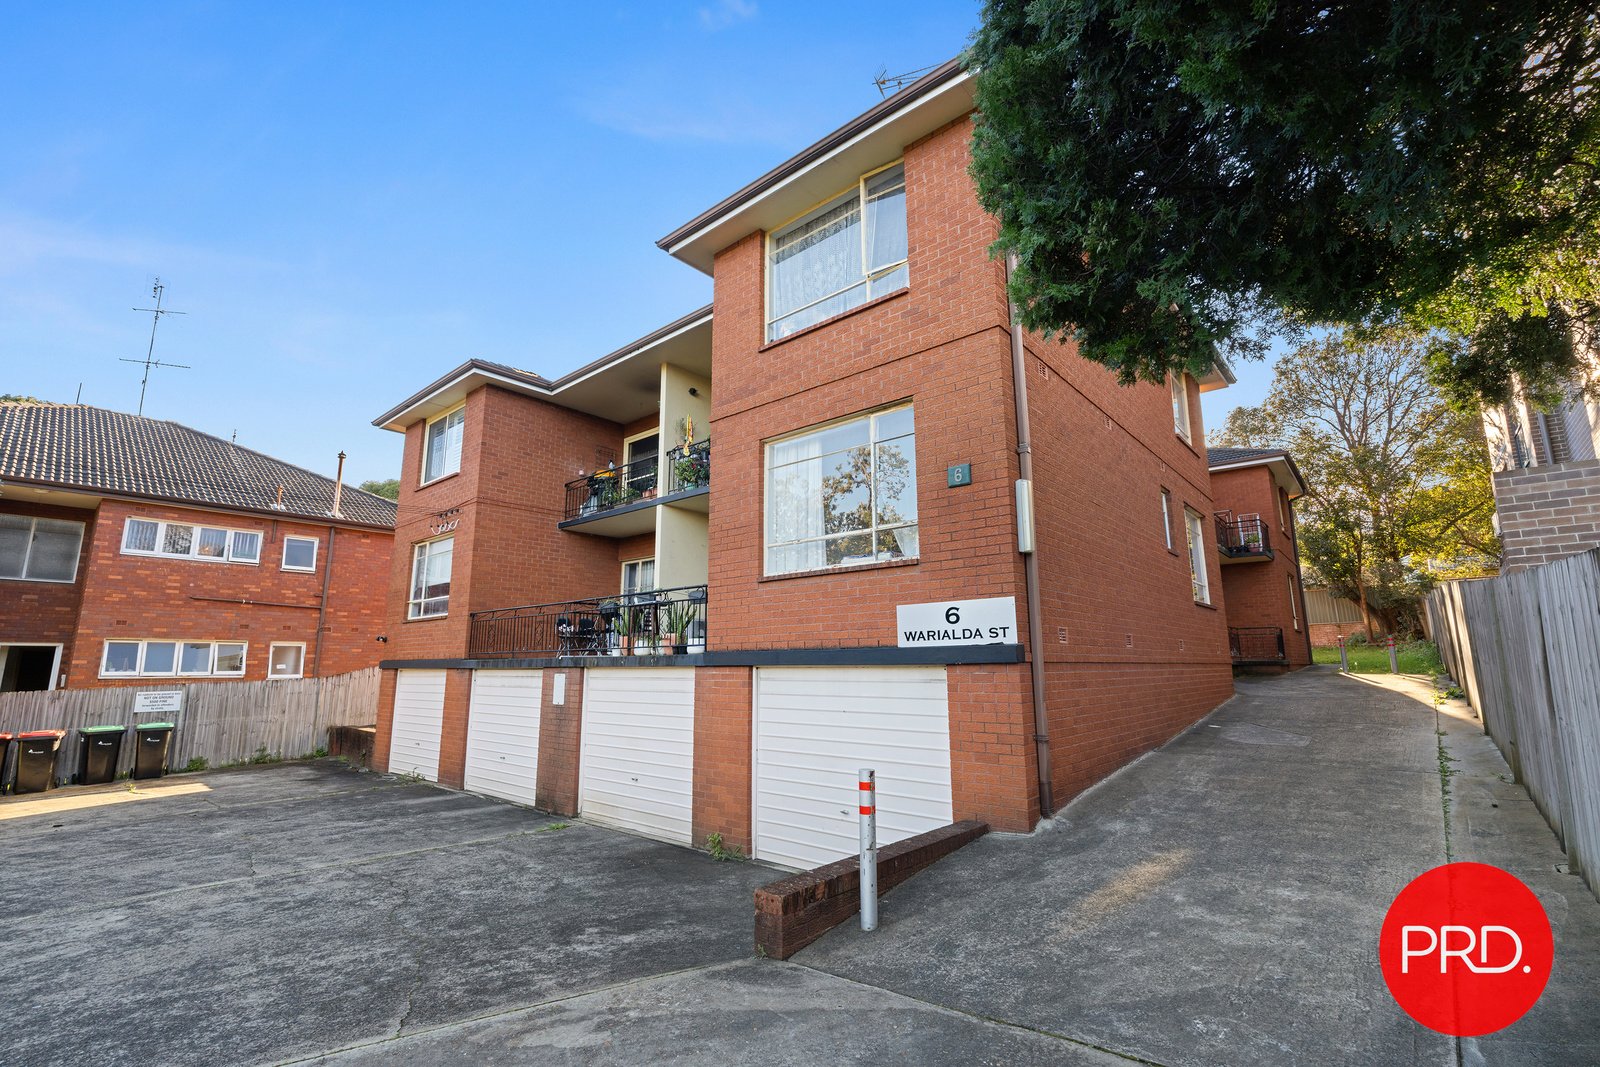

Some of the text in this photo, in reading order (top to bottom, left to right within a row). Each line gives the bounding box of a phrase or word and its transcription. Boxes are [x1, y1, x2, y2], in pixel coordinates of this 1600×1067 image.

[954, 467, 963, 482] 6
[945, 606, 960, 625] 6
[903, 626, 1010, 642] WARIALDA ST
